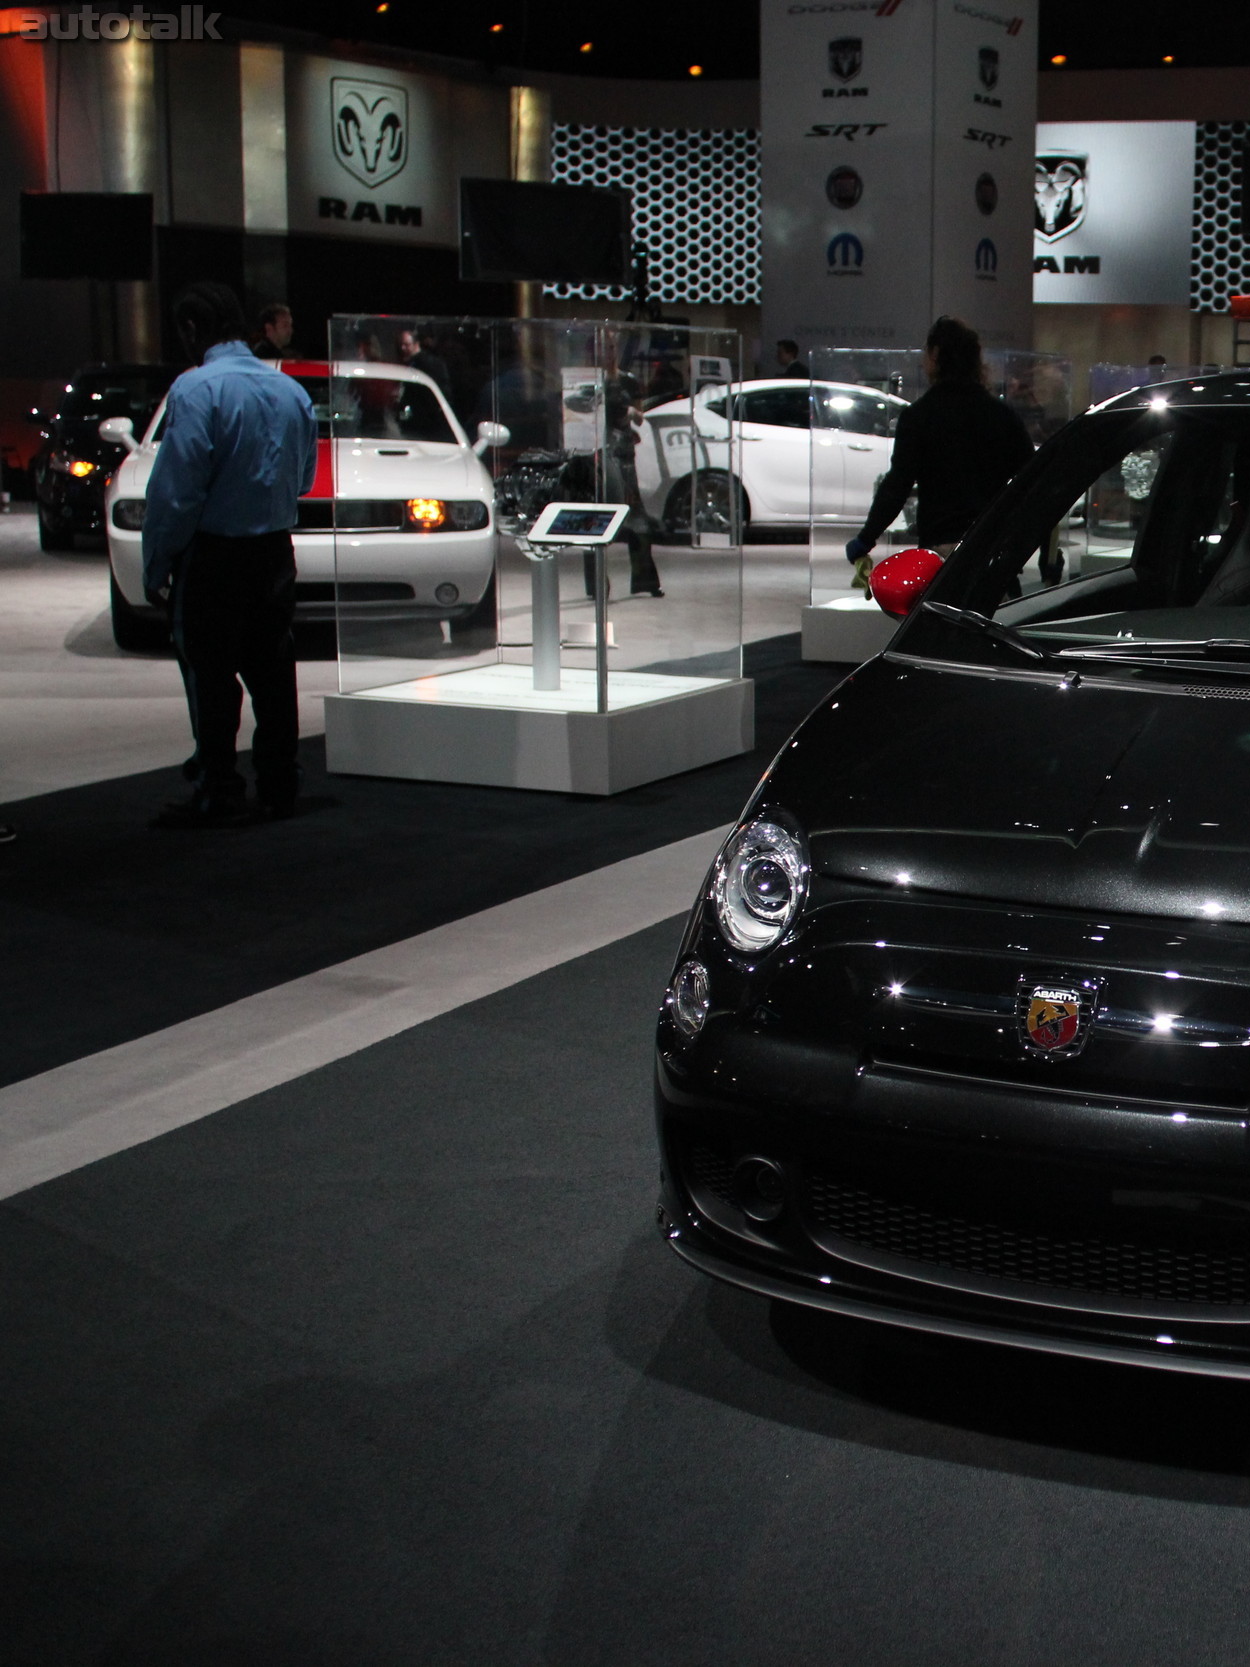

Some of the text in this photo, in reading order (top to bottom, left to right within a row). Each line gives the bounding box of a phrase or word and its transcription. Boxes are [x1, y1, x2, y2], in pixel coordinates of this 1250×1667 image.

[822, 87, 869, 98] RAM
[973, 94, 1002, 108] RAM
[804, 123, 888, 142] SRT
[962, 128, 1013, 150] SRT
[317, 196, 422, 228] RAM
[1033, 256, 1101, 274] AM
[1033, 990, 1077, 1002] ABARTH
